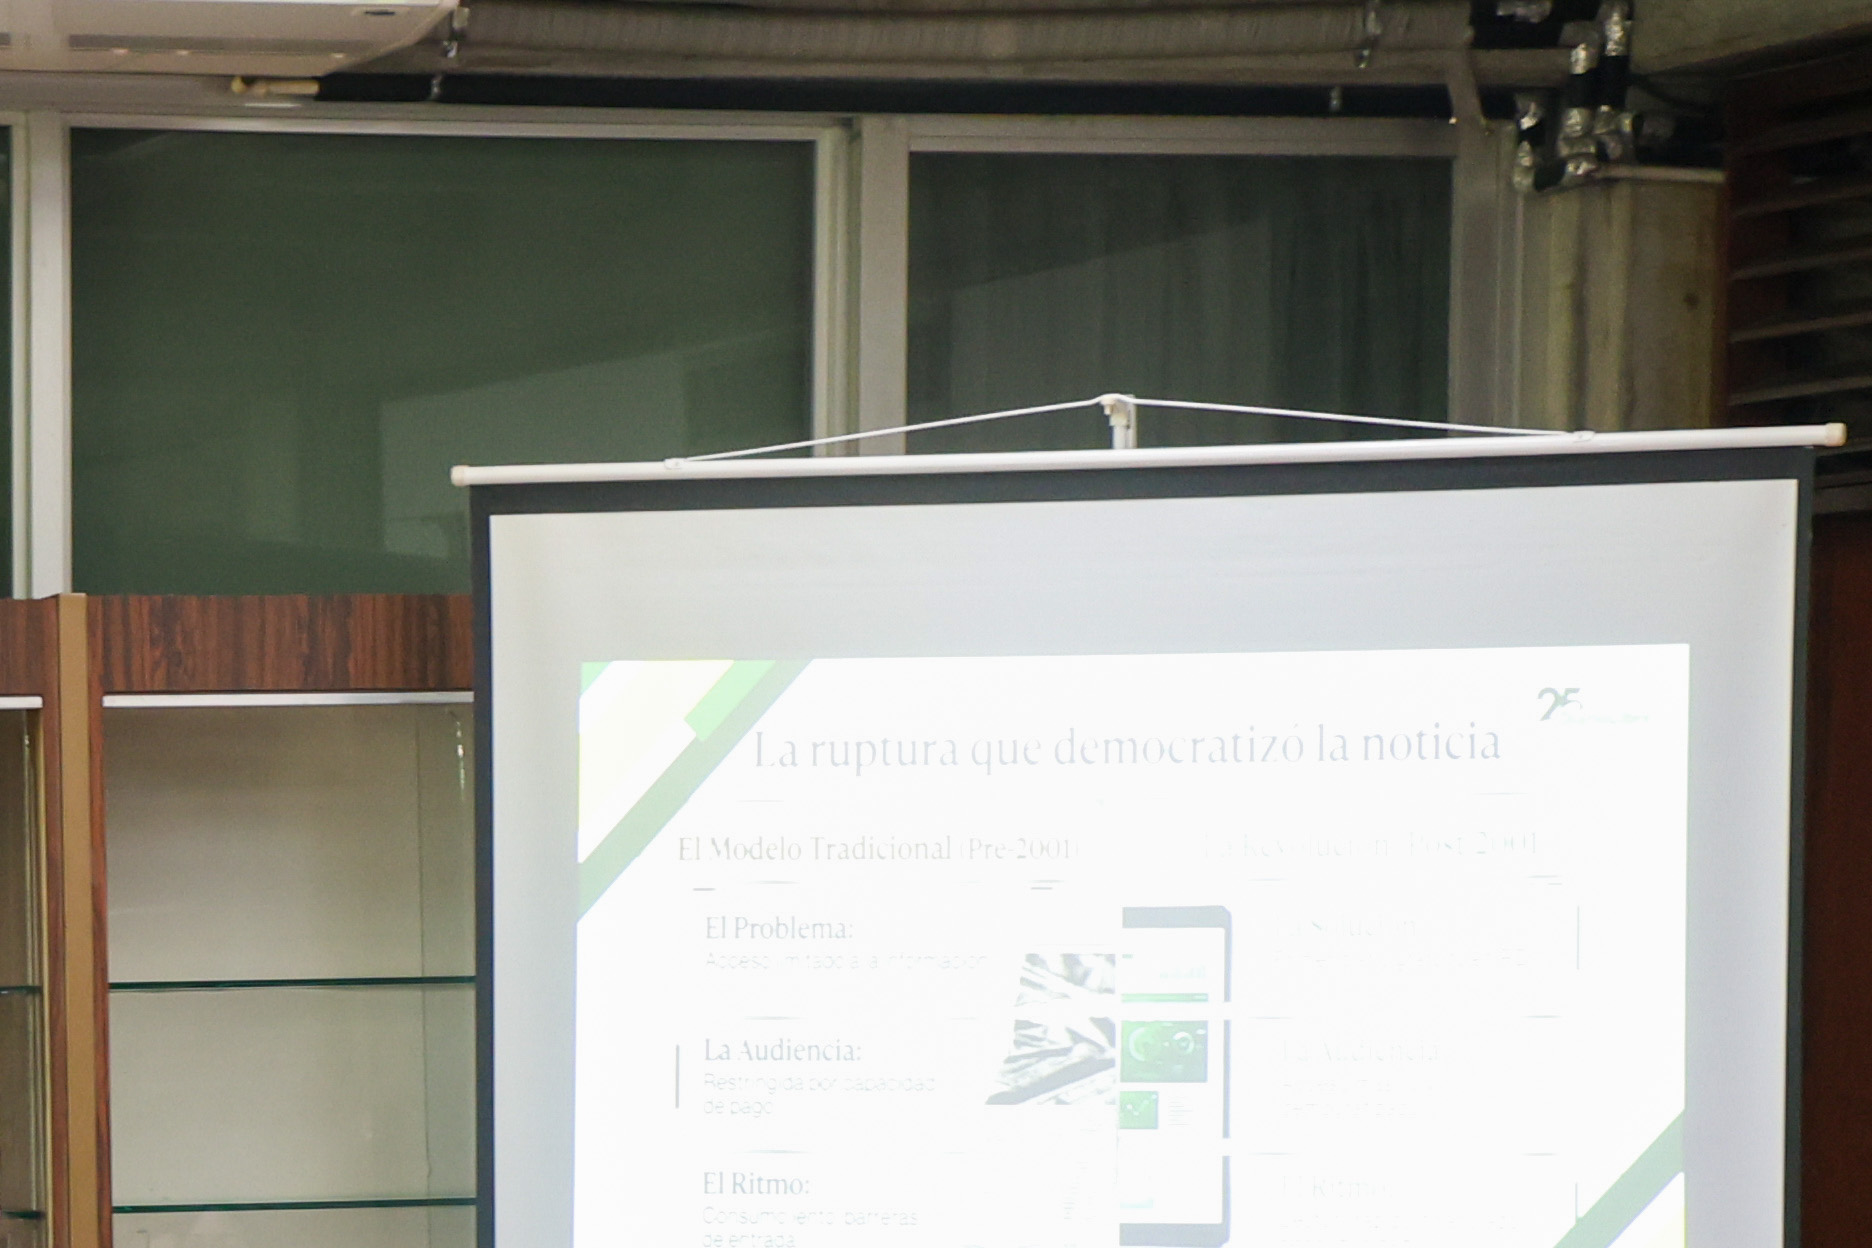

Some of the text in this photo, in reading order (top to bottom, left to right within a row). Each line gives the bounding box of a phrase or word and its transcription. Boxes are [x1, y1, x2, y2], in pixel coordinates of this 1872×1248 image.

[754, 721, 1501, 777] La ruptura que democratizó la noticia
[678, 836, 700, 860] El
[711, 836, 802, 861] Modelo
[810, 835, 951, 861] Tradicional
[706, 915, 853, 939] El Problema:
[704, 1038, 861, 1062] La Audiencia:
[704, 1171, 810, 1195] El Ritmo:
